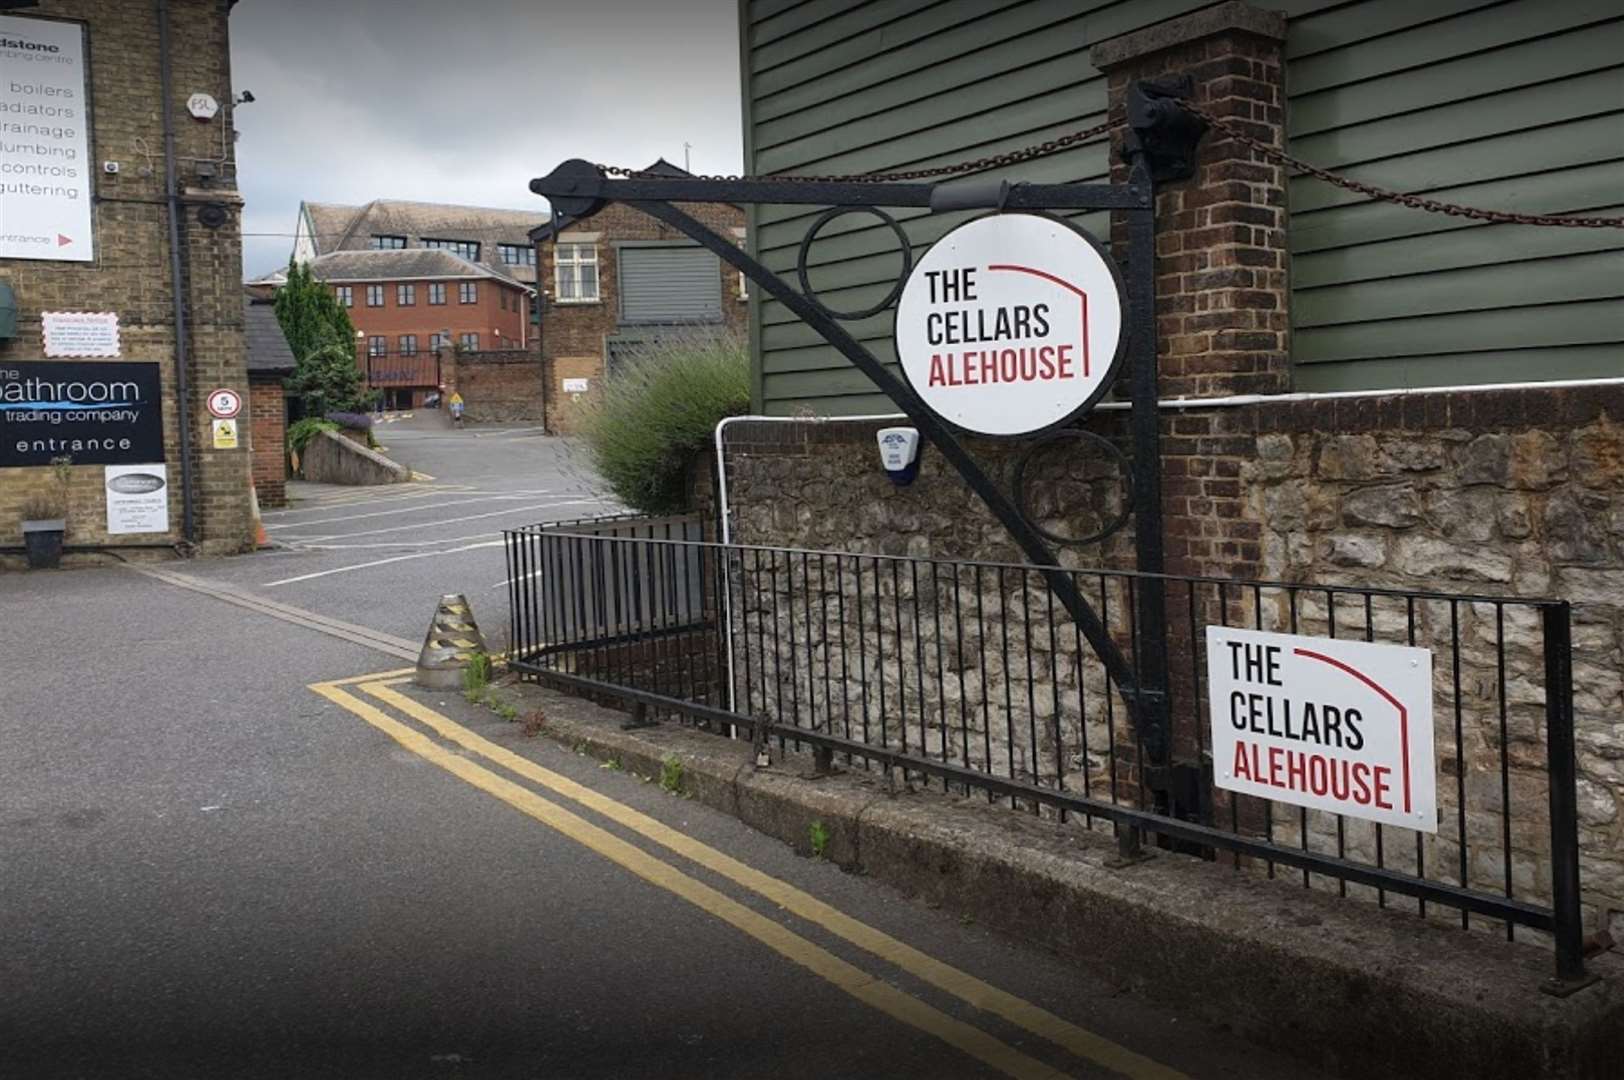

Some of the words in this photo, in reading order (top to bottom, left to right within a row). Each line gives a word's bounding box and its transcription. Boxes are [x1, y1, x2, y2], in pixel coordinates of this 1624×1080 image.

[10, 80, 74, 98] boilers
[2, 162, 77, 178] controls
[925, 267, 978, 304] THE
[927, 303, 1050, 345] CELLARS
[929, 344, 1074, 387] ALEHOUSE
[0, 377, 139, 401] athroom
[5, 410, 62, 424] trading
[66, 409, 139, 423] company
[16, 438, 131, 451] entrance
[1227, 641, 1282, 686] THE
[1230, 691, 1364, 751] CELLARS
[1234, 740, 1393, 810] ALEHOUSE
